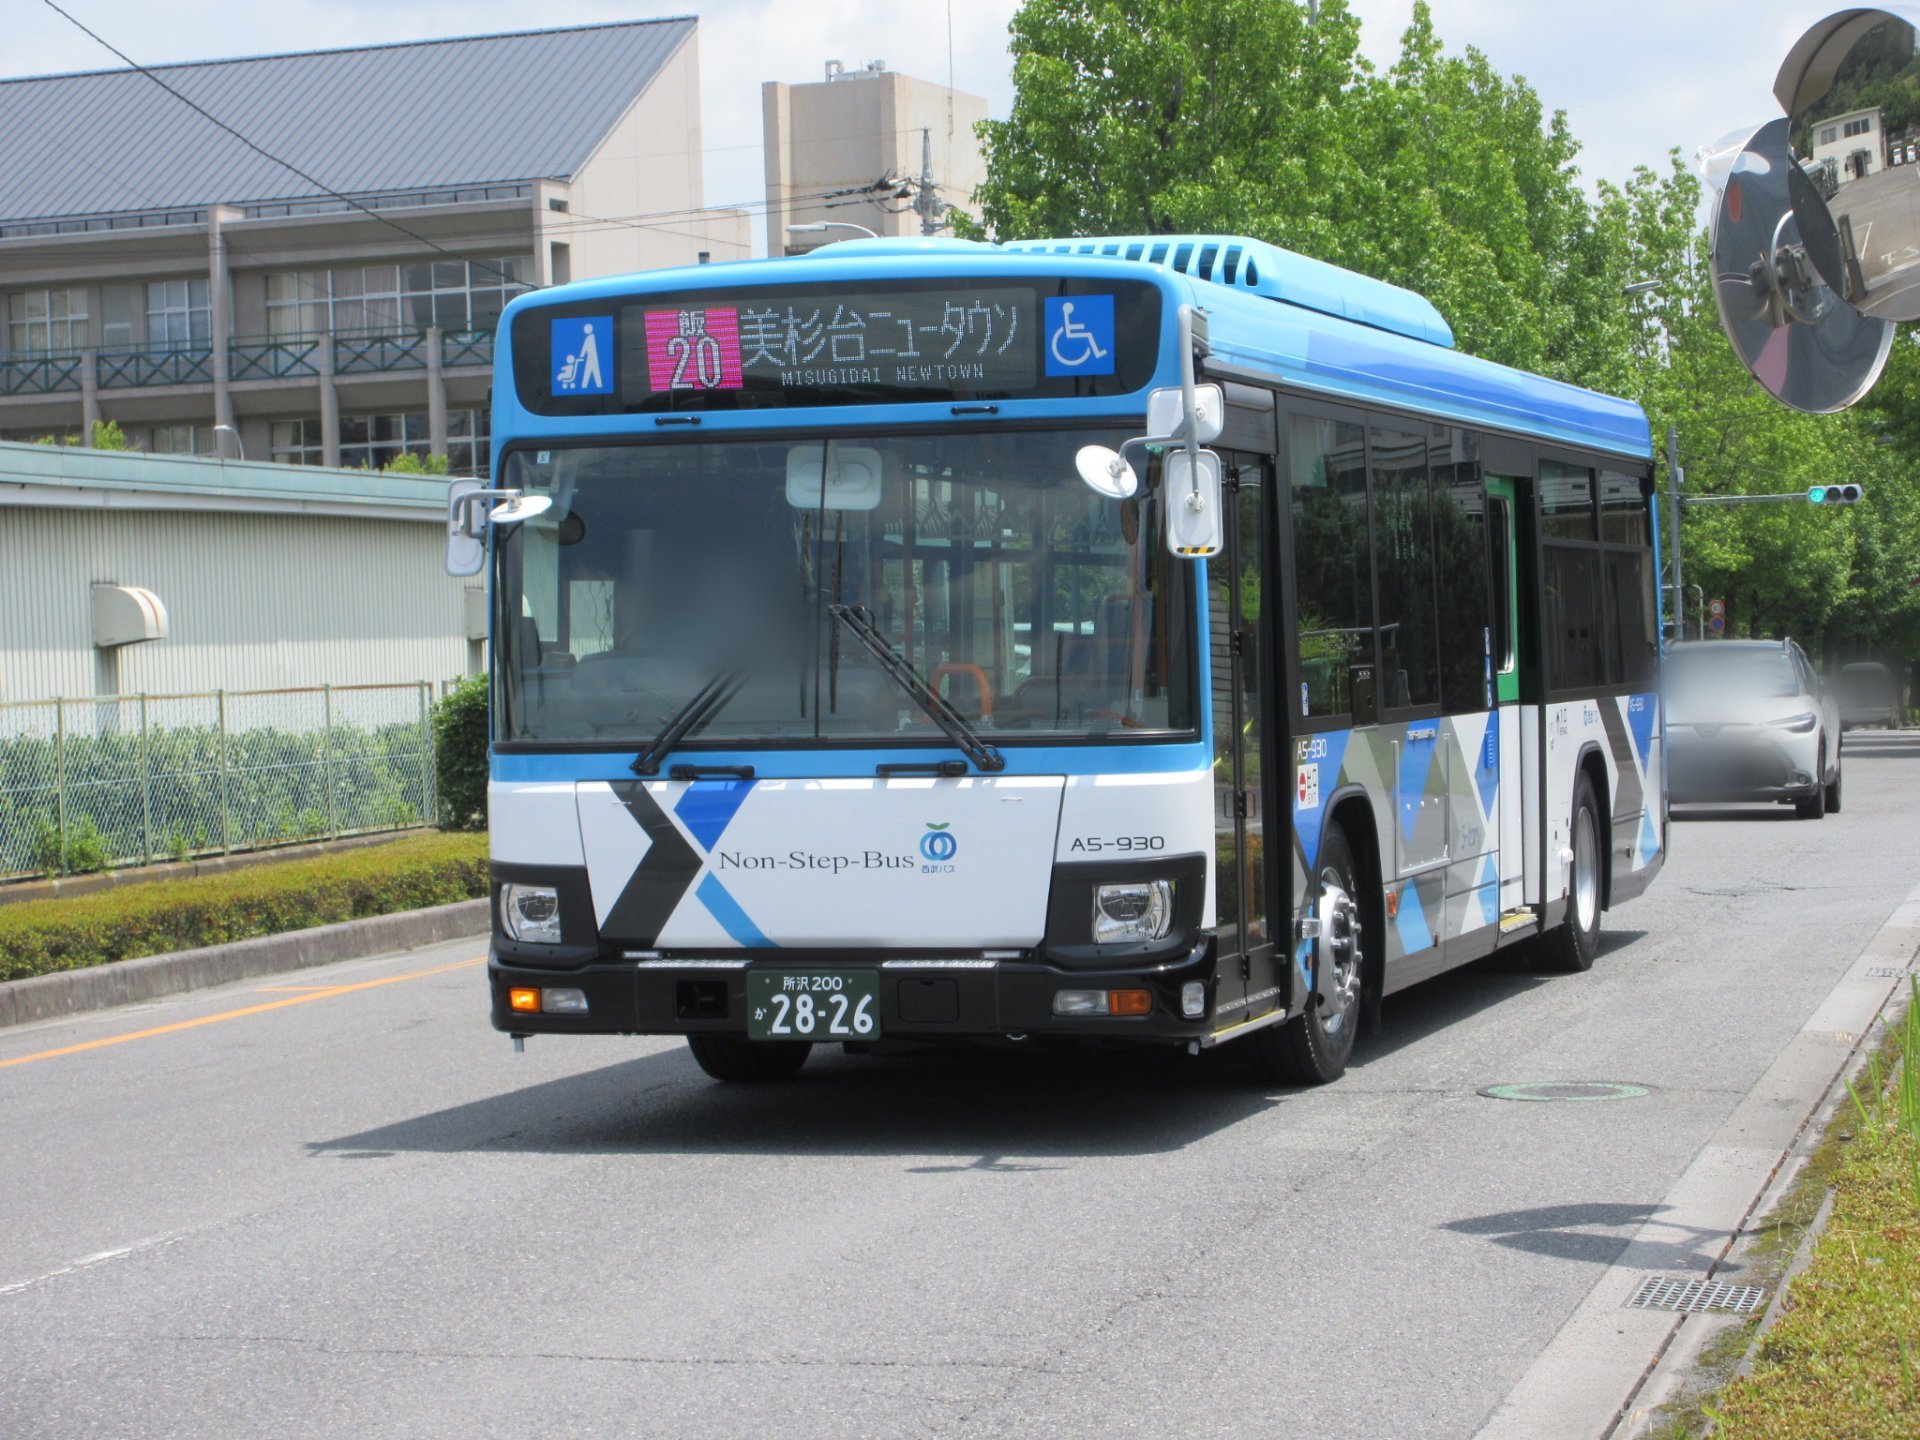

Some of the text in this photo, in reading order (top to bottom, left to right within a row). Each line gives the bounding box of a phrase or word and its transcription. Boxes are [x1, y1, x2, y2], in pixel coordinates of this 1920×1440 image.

[740, 299, 1017, 368] 美杉台ニュータウン
[667, 336, 722, 389] 20
[781, 363, 984, 386] MISUGIDAI NEWTOWN
[1297, 739, 1327, 760] A5-930
[1070, 836, 1165, 852] A5-930
[719, 850, 915, 875] Non-Step-Bus
[921, 864, 955, 874] 西武バス
[754, 993, 874, 1034] か 28-26
